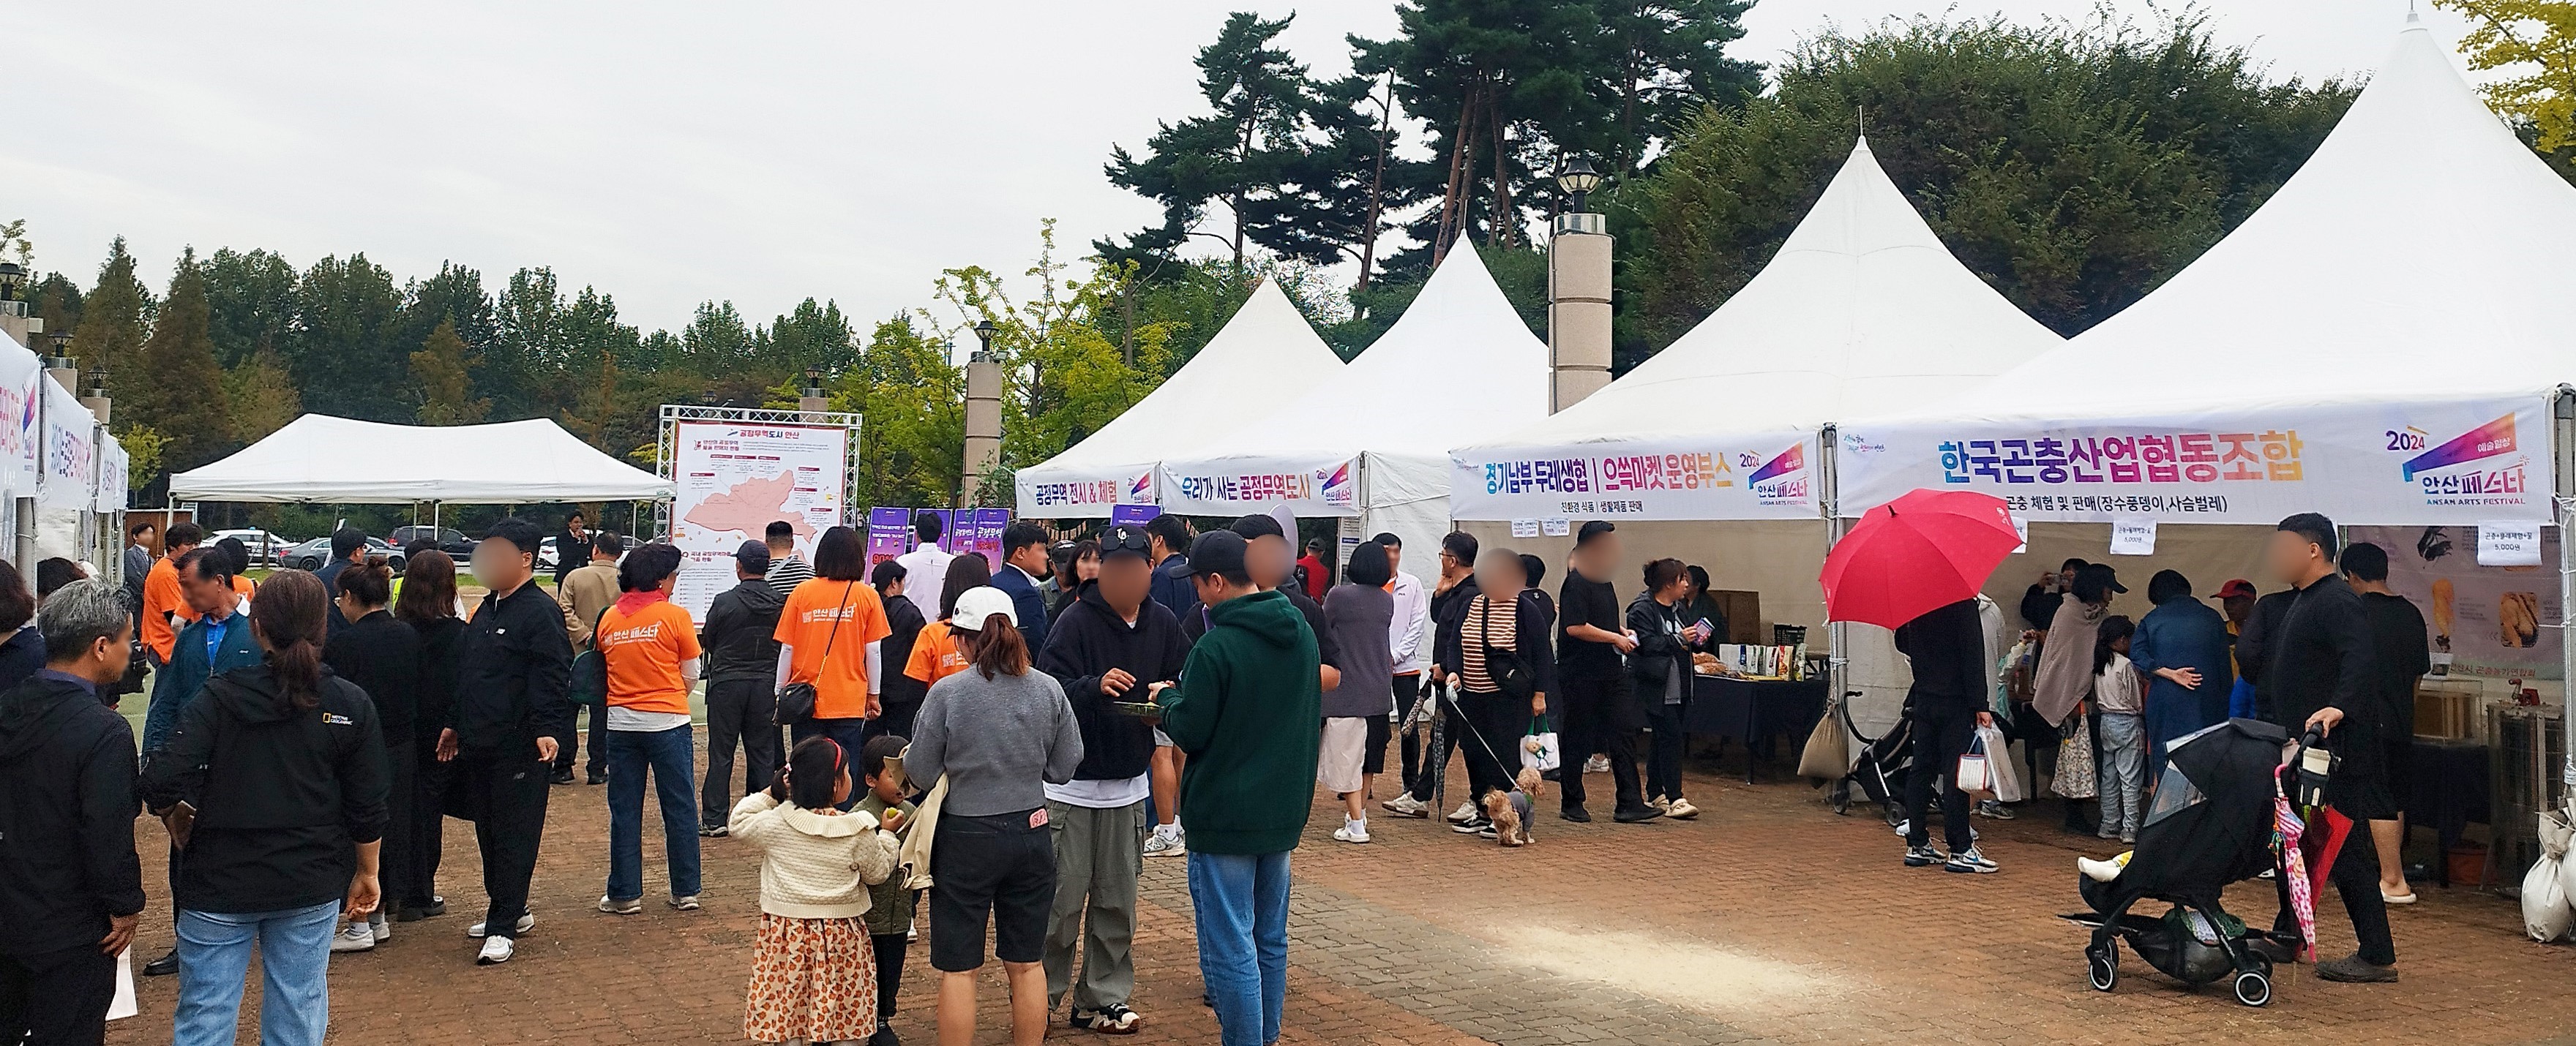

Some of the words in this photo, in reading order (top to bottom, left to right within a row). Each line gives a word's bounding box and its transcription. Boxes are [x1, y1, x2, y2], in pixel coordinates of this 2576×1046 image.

[785, 431, 800, 440] 안산
[2386, 430, 2425, 451] 2024
[1740, 453, 1759, 467] 2024
[1939, 429, 2304, 484] 한국곤충산업협동조합
[1486, 461, 1533, 494] 경기남부
[1535, 458, 1589, 493] 두레생협
[1603, 455, 1665, 491] 으쓱마켓
[1665, 451, 1734, 490] 운영부스
[1036, 484, 1068, 505] 공정무역
[1069, 482, 1087, 505] 전시
[1089, 481, 1096, 504] &
[1098, 480, 1117, 503] 체험
[1182, 476, 1213, 501] 우리가
[1217, 476, 1238, 501] 사는
[1240, 473, 1311, 501] 공정무역도시
[1561, 501, 1580, 513] 친환경
[1581, 501, 1594, 513] 식품
[1600, 500, 1627, 513] 생활제품
[1628, 500, 1643, 513] 판매
[2006, 496, 2028, 511] 곤충
[2031, 496, 2053, 511] 체험
[2057, 496, 2069, 511] 및
[2073, 495, 2228, 513] 판매(장수풍뎅이,사슴벌레)
[2495, 543, 2520, 552] 5,000원
